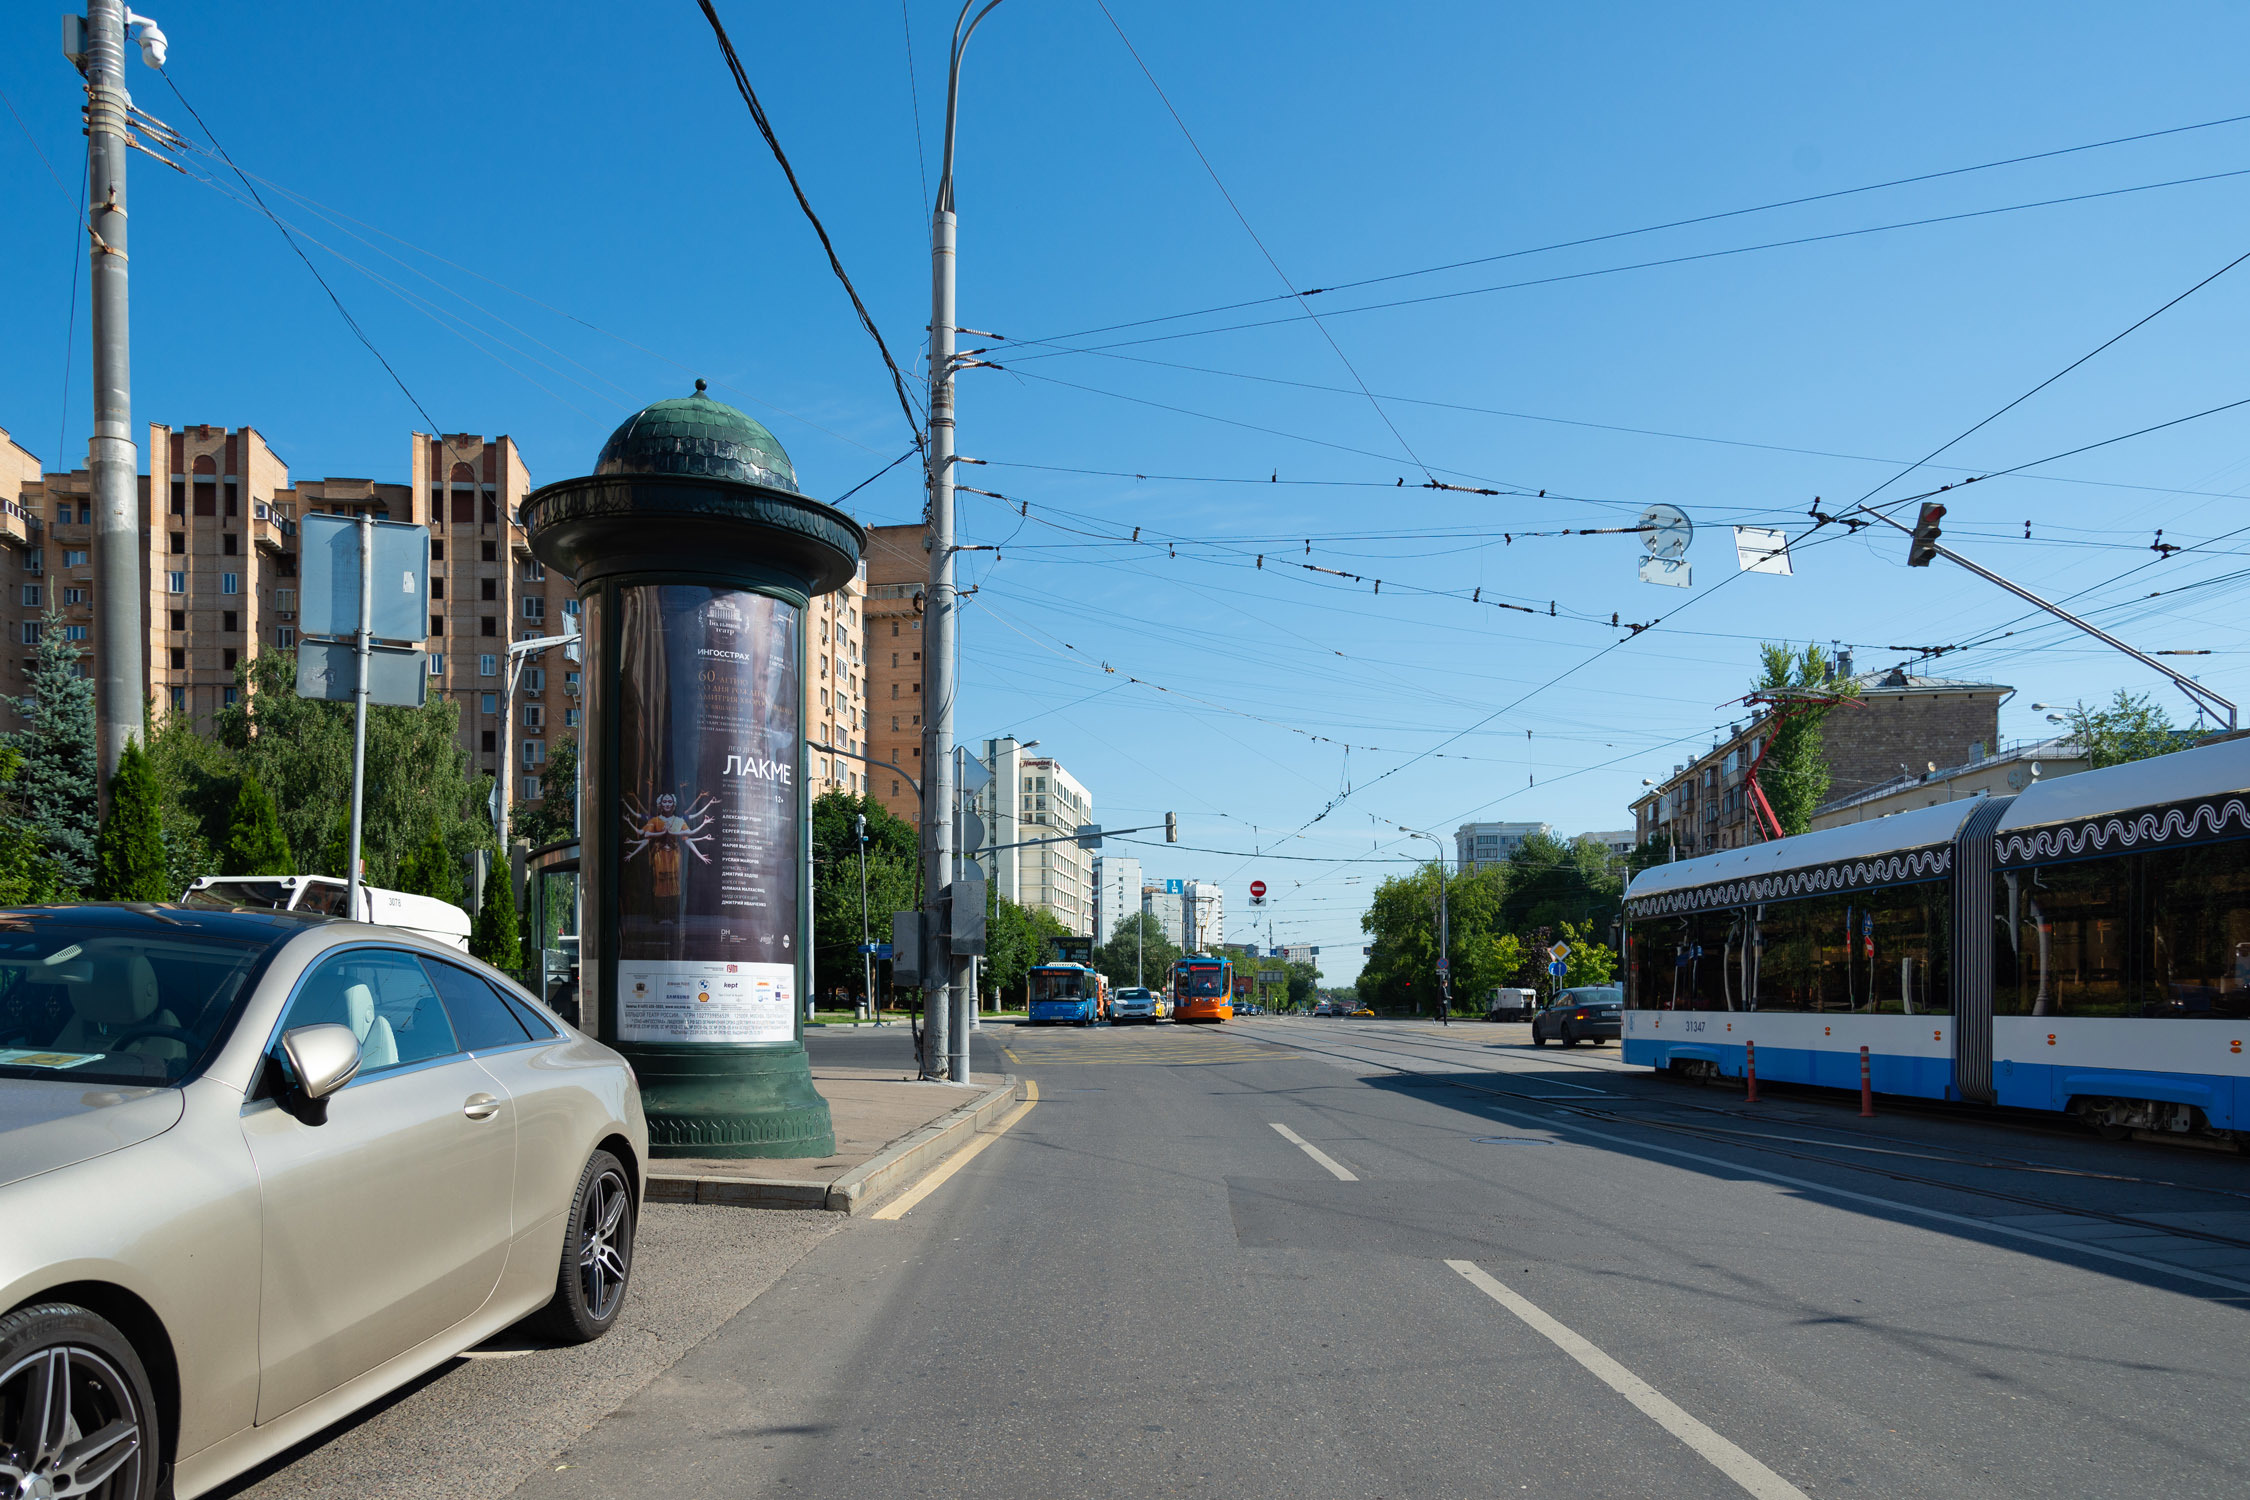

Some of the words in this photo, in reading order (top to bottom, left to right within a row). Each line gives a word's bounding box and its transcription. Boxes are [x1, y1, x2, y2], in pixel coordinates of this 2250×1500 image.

[697, 648, 750, 661] ИНГОССТРАХ
[722, 754, 792, 785] ЛАКМЕ
[1019, 760, 1052, 768] Hampton
[388, 897, 401, 907] 3078
[723, 982, 739, 990] kept
[1685, 1020, 1705, 1032] 31347
